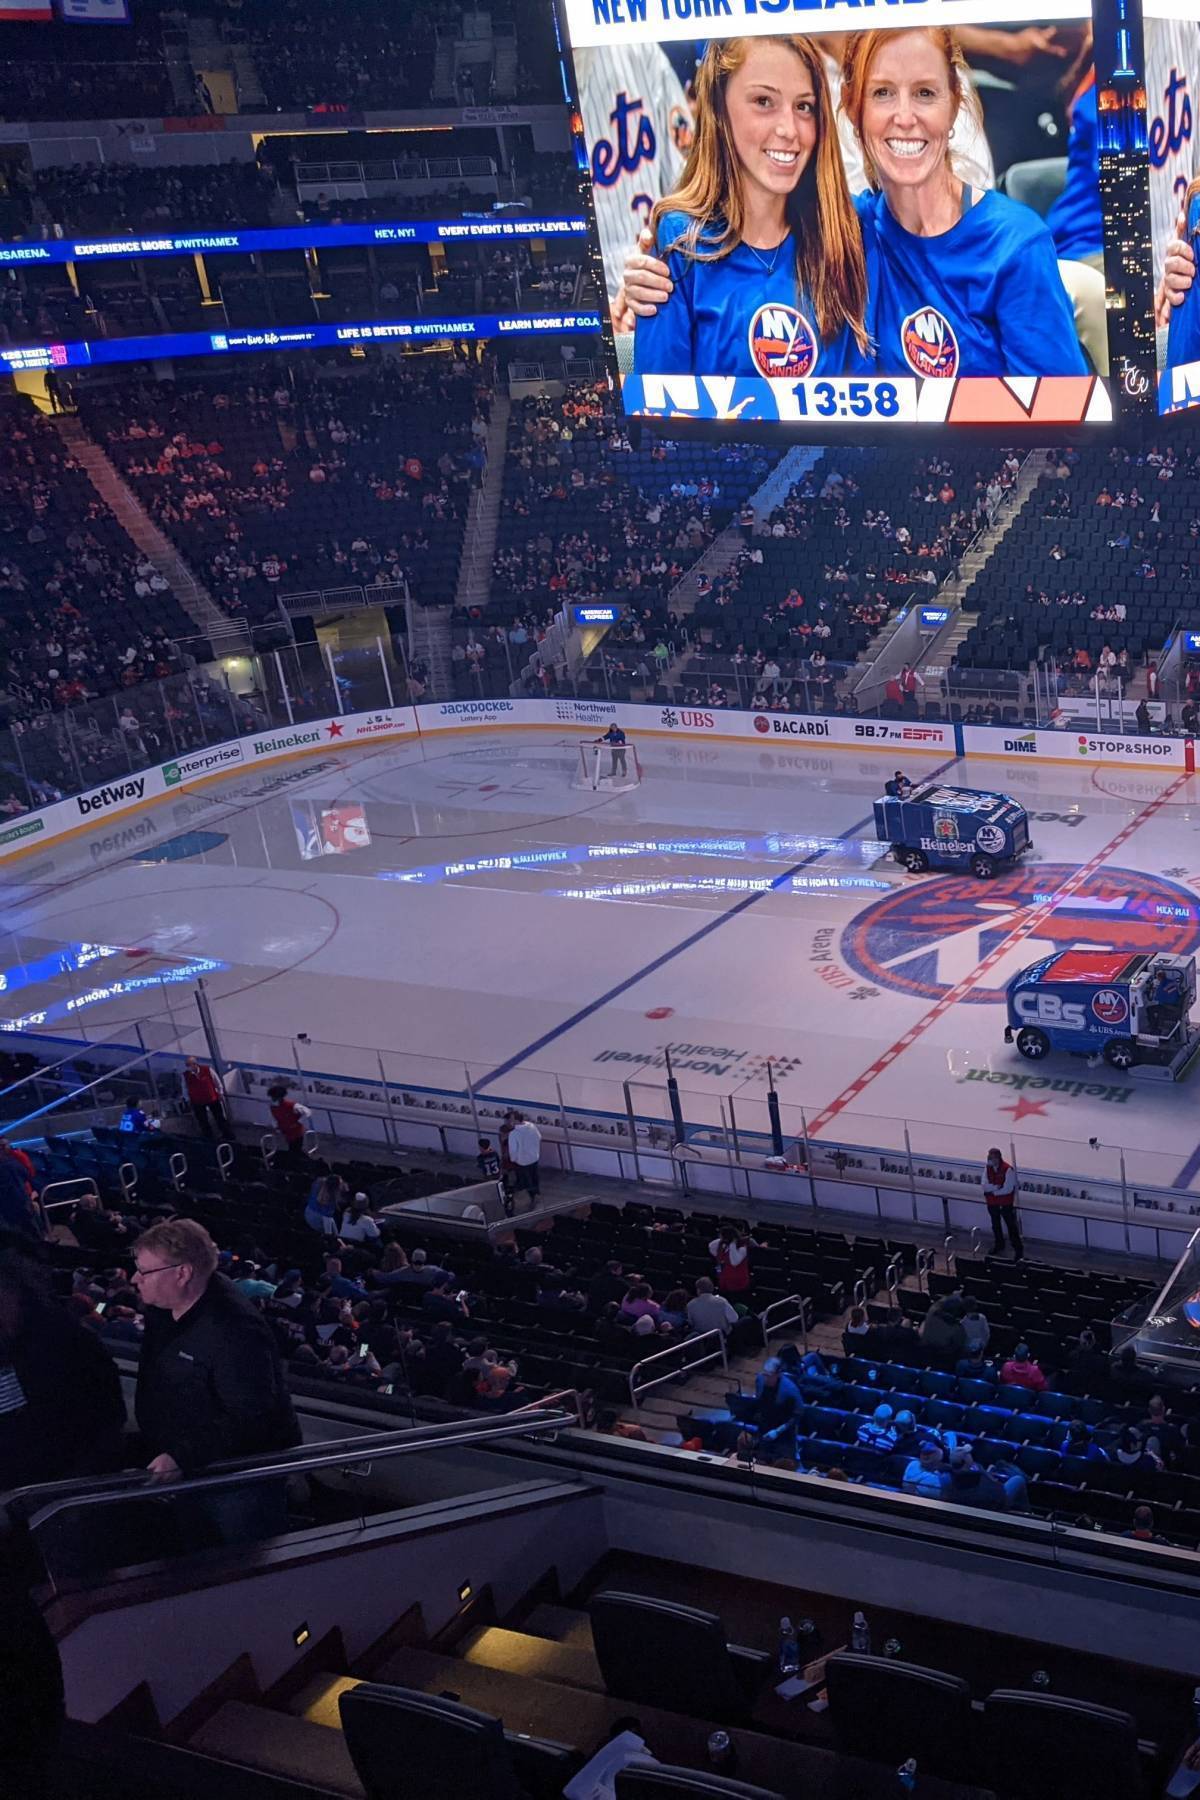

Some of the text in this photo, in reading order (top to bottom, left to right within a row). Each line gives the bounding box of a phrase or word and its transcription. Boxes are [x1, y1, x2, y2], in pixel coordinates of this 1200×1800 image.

[375, 229, 416, 239] HEY, NY!
[438, 221, 570, 236] EVERY EVENT IS NEXT-LEVEL
[75, 237, 239, 255] EXPERIENCE MORE #WITHAMEX
[337, 323, 475, 339] LIFE IS BETTER #WITHAMEX
[499, 320, 531, 330] LEARN
[532, 319, 563, 330] MORE
[564, 318, 576, 327] AT
[247, 335, 264, 346] live
[264, 333, 279, 345] life
[792, 382, 899, 417] 13:58
[573, 702, 617, 714] Northwell
[461, 714, 497, 723] Lottery App
[574, 711, 603, 722] Health
[681, 711, 714, 728] UBS
[356, 721, 405, 735] NHLSHOP.com
[773, 718, 830, 736] BACARDÍ
[855, 724, 889, 738] 98.7
[902, 728, 944, 742] ESPN
[253, 729, 320, 754] Heineken
[1004, 739, 1037, 753] DIME
[1088, 740, 1171, 756] STOP&SHOP
[167, 748, 240, 779] enterprise
[77, 778, 145, 815] betway
[920, 837, 976, 853] Heineken
[809, 928, 855, 988] UBS Arena
[1098, 1026, 1114, 1035] UBS
[666, 1042, 748, 1062] Health
[594, 1049, 731, 1077] Northwell
[965, 1069, 1135, 1103] Heineken
